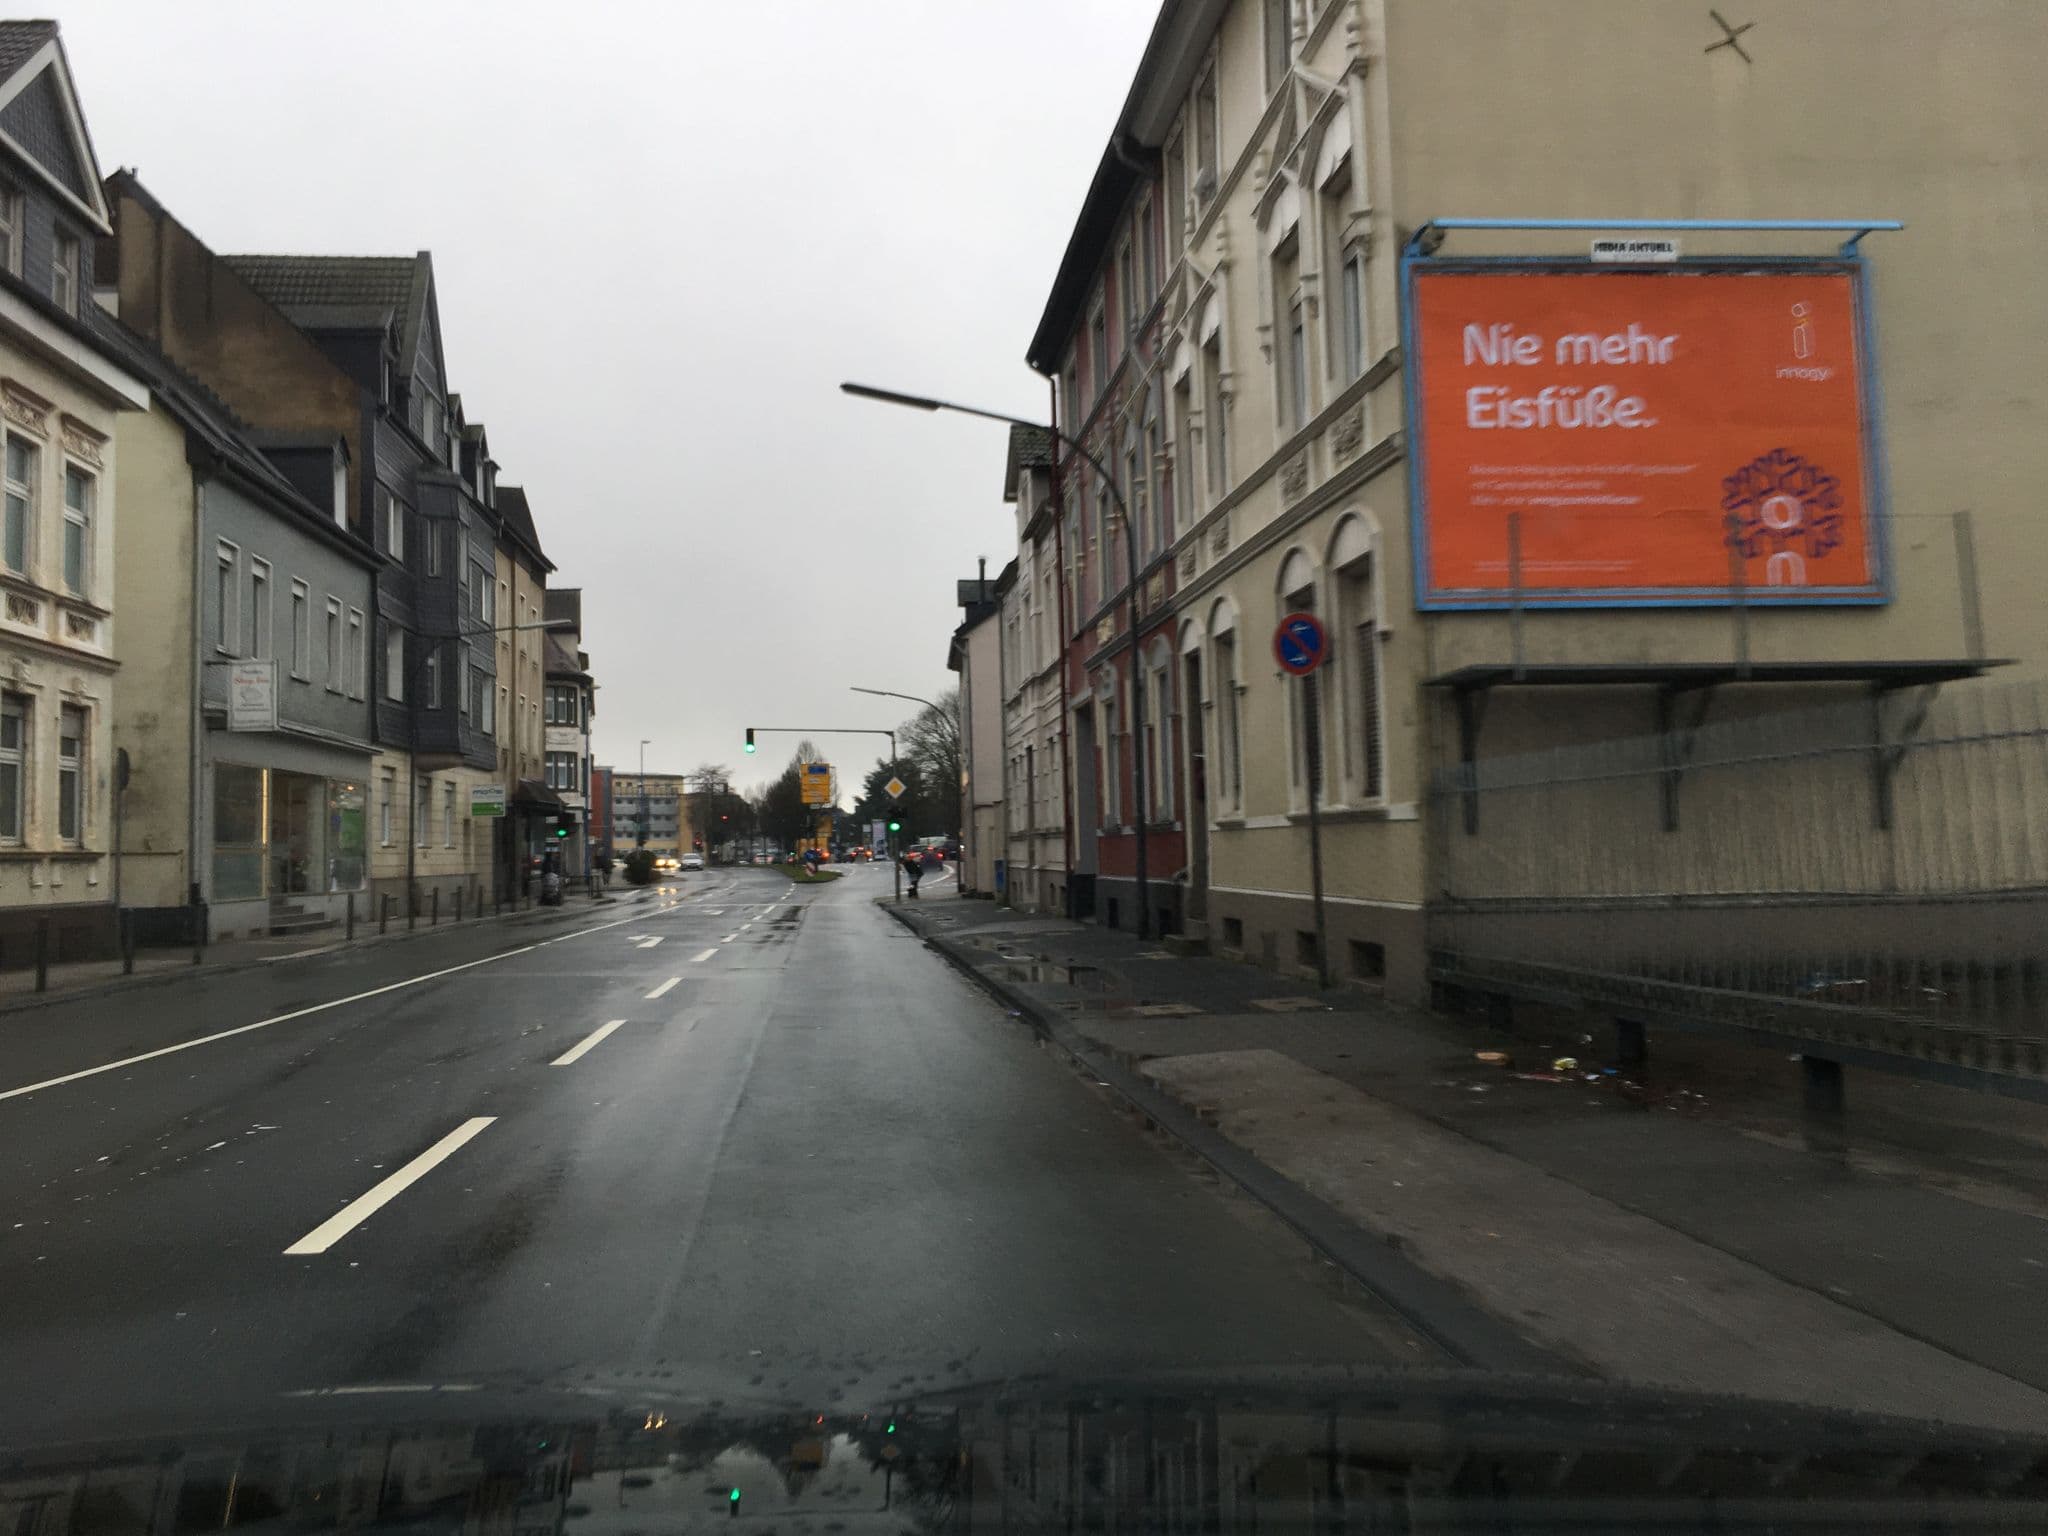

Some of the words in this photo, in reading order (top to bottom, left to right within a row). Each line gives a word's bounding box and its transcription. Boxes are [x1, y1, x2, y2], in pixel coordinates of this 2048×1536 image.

[1463, 323, 1543, 366] Nie
[1556, 322, 1679, 365] mehr
[1465, 384, 1659, 430] Eisfüße.
